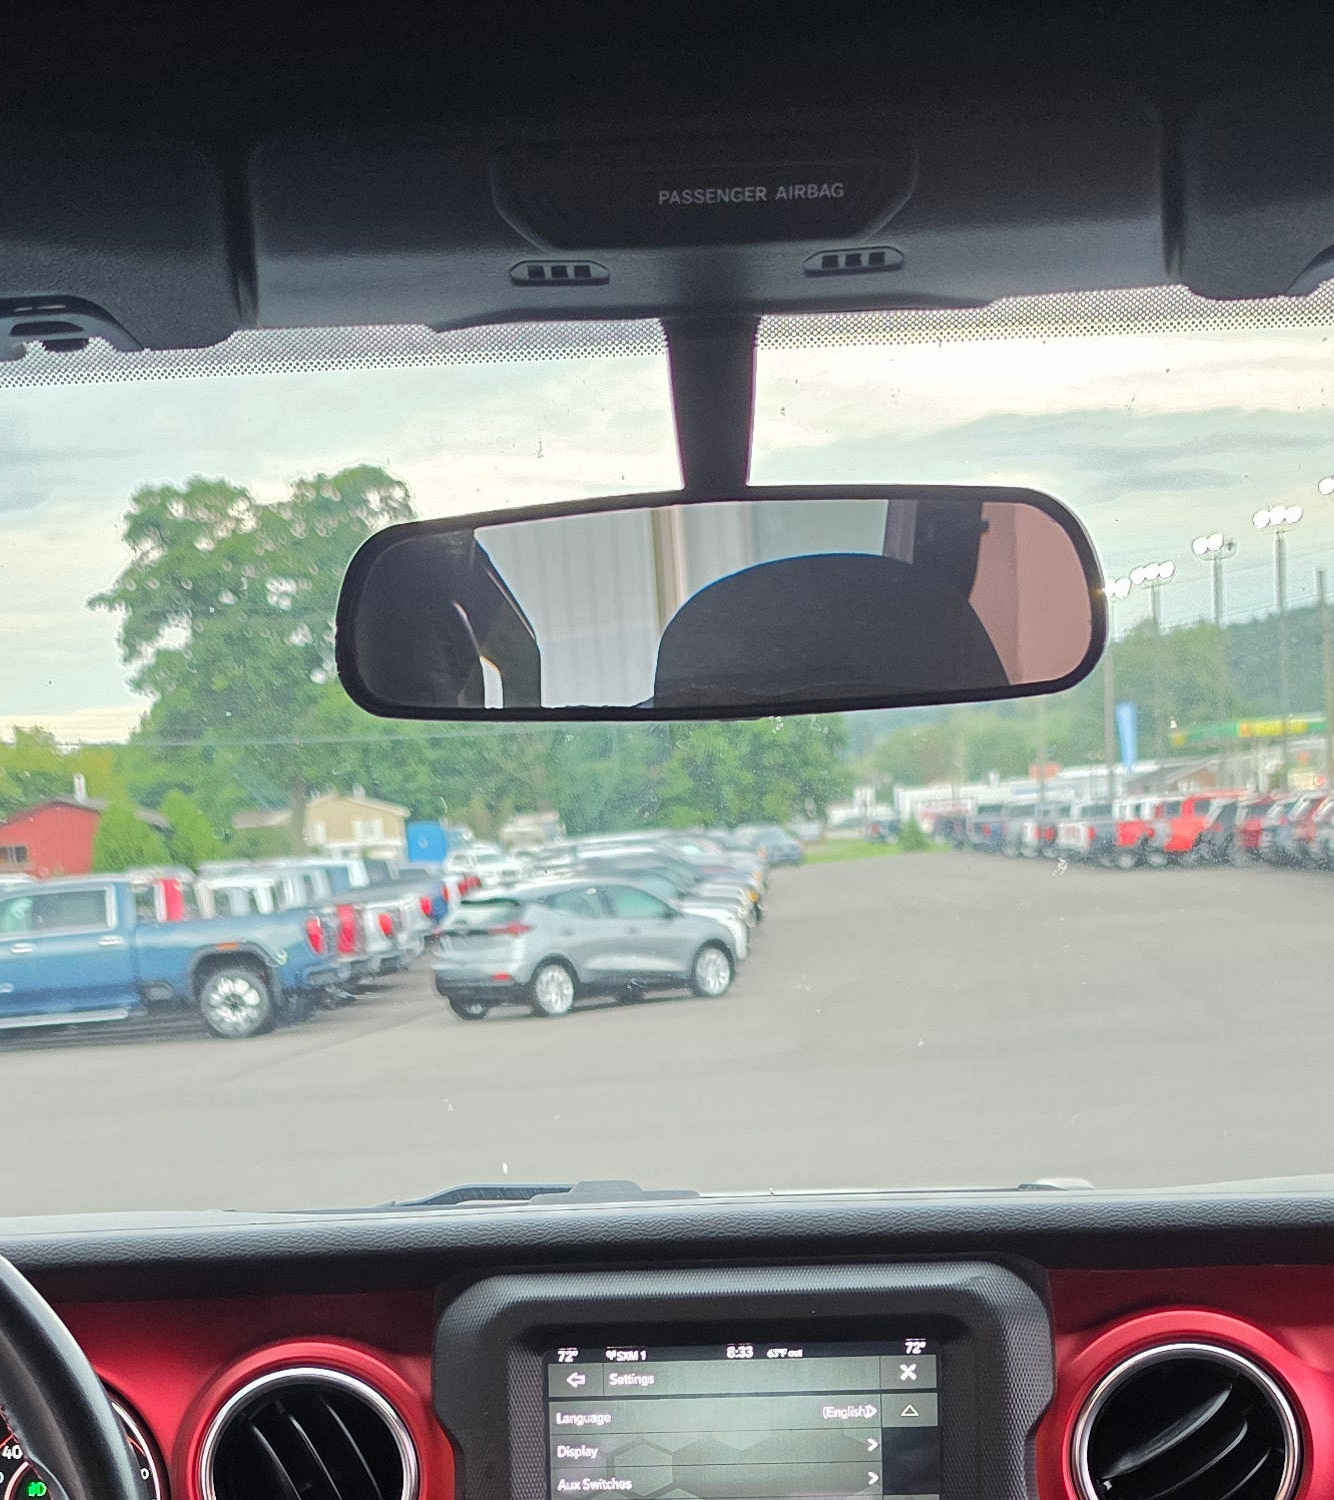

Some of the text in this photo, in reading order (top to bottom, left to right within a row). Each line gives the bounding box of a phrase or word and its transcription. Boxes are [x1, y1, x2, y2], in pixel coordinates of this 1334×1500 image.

[658, 182, 845, 206] PASSENGER AIRBAG
[726, 1346, 754, 1359] 8:33
[609, 1373, 655, 1386] Settings
[556, 1413, 611, 1425] Language
[2, 1444, 23, 1460] 40
[557, 1445, 598, 1459] Display
[557, 1478, 632, 1491] Aux Switches
